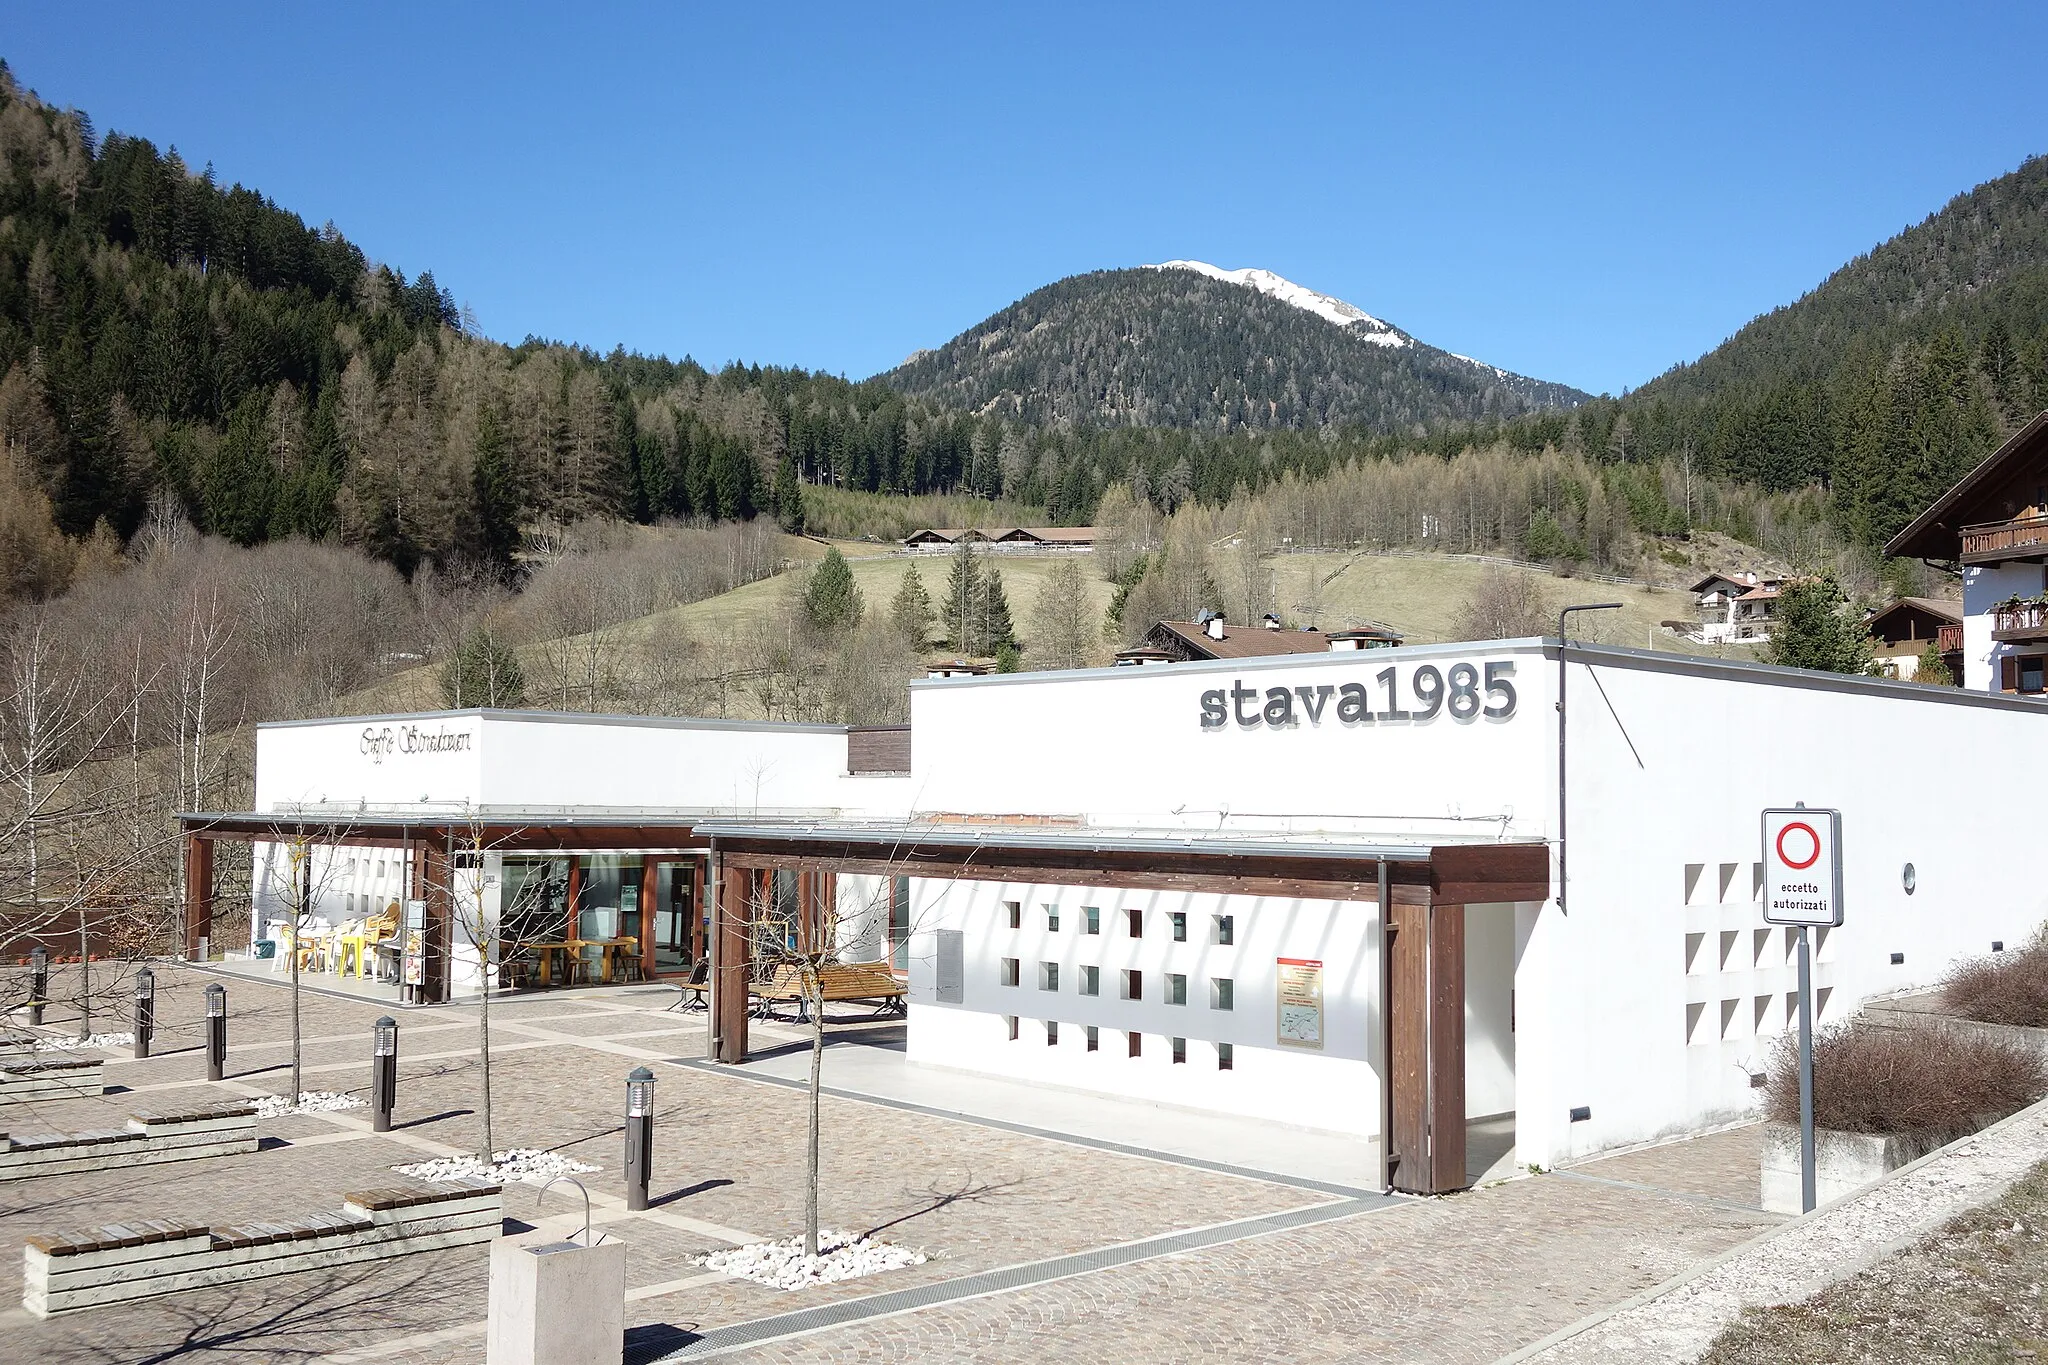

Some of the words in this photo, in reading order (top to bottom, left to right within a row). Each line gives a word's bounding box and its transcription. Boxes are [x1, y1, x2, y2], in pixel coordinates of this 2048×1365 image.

[1200, 661, 1518, 730] stava1985
[1781, 883, 1818, 894] eccetto
[1773, 899, 1827, 911] autorizzati
